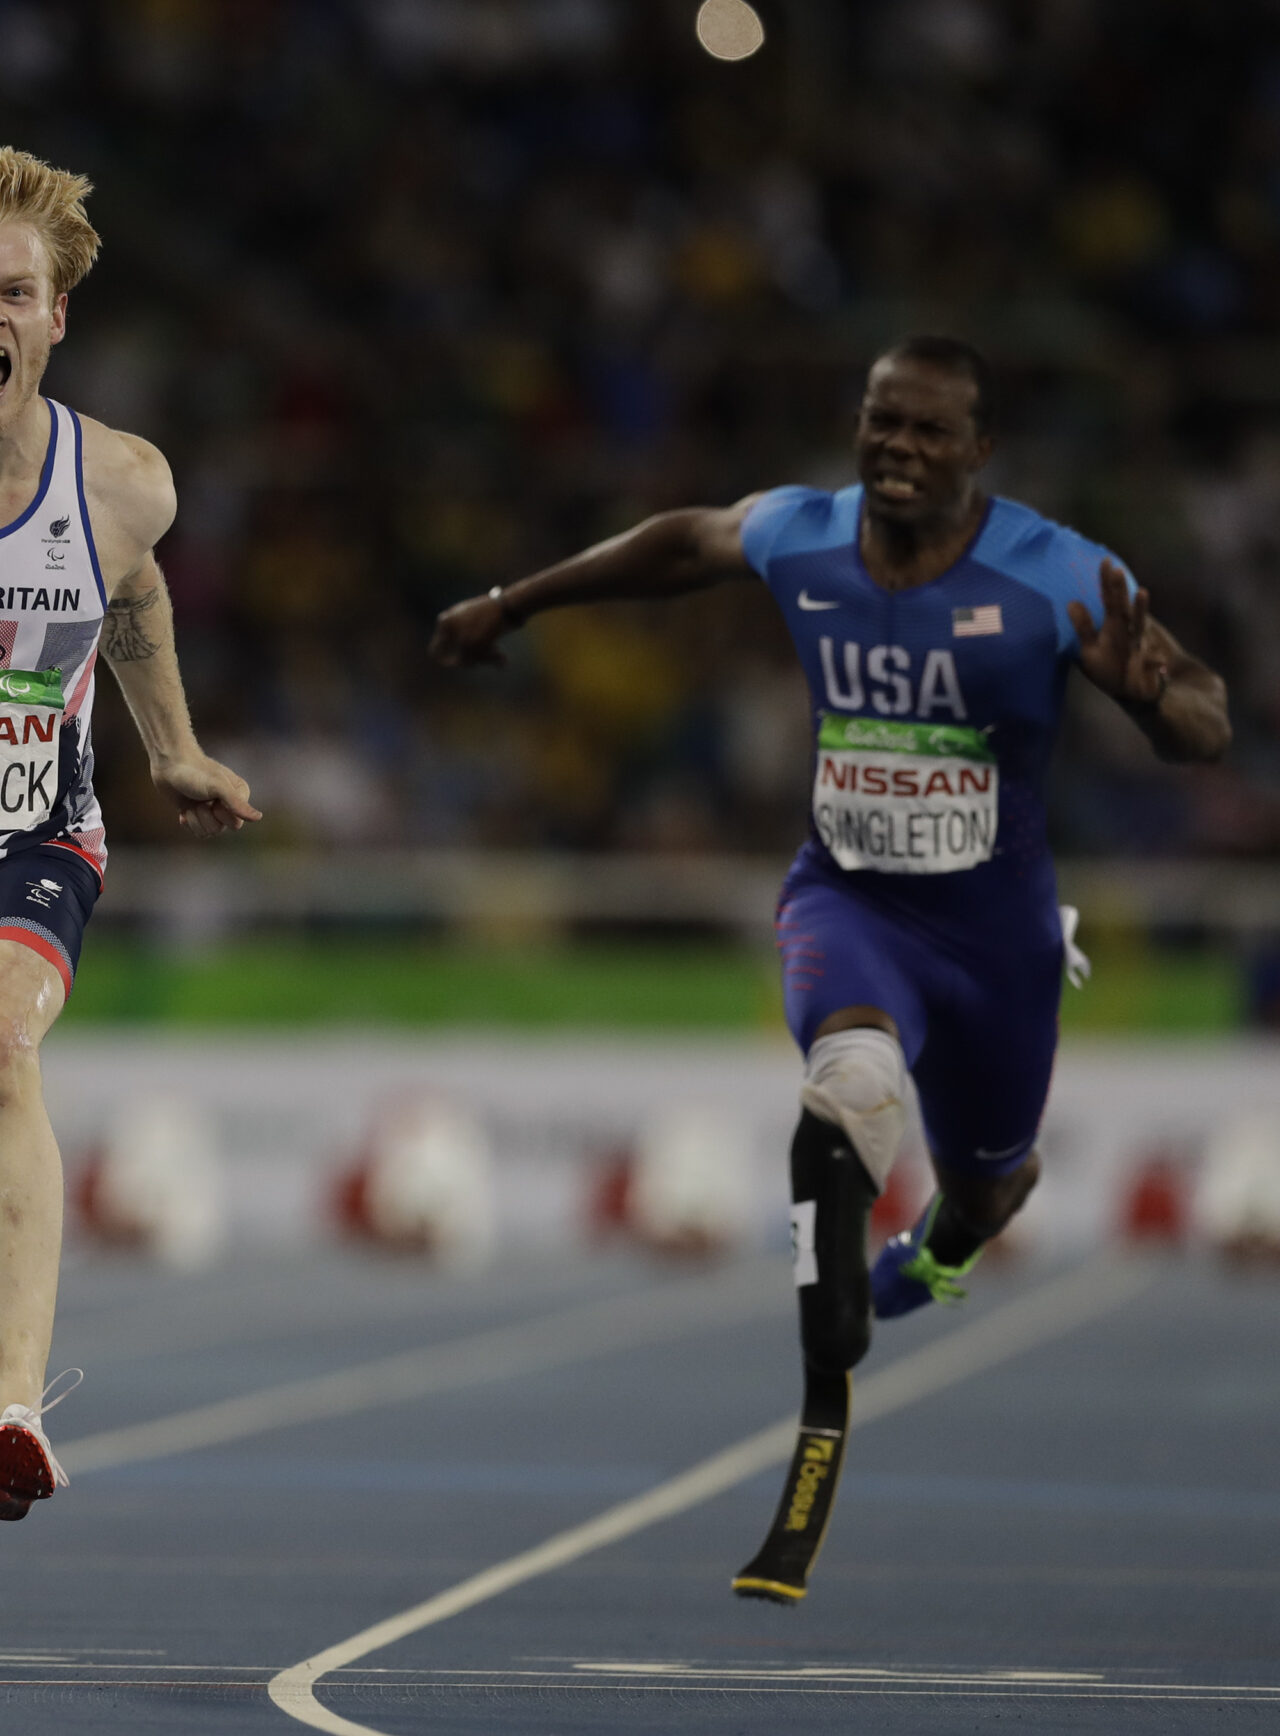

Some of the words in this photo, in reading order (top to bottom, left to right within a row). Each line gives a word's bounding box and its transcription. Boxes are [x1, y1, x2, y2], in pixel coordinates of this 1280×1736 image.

[820, 636, 968, 720] USA
[821, 758, 992, 798] NISSAN
[819, 803, 991, 858] SINGLETON
